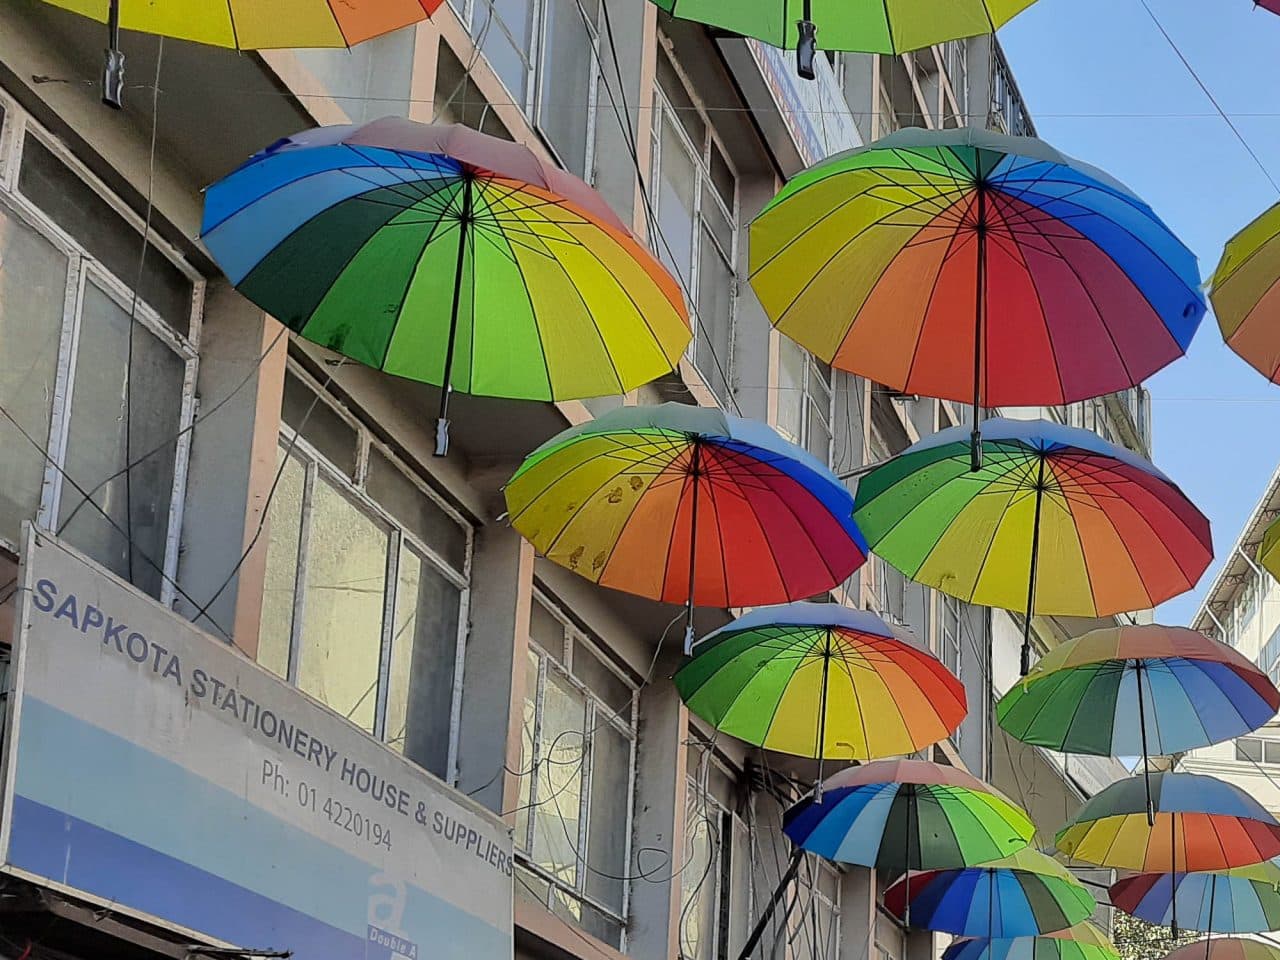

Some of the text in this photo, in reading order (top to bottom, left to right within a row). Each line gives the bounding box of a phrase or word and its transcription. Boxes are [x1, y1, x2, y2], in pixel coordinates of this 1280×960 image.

[33, 579, 513, 877] SAPKOTA STATIONERY HOUSE & SUPPLIERS
[261, 760, 392, 851] Ph: 01 4220194
[369, 927, 417, 959] Double A
